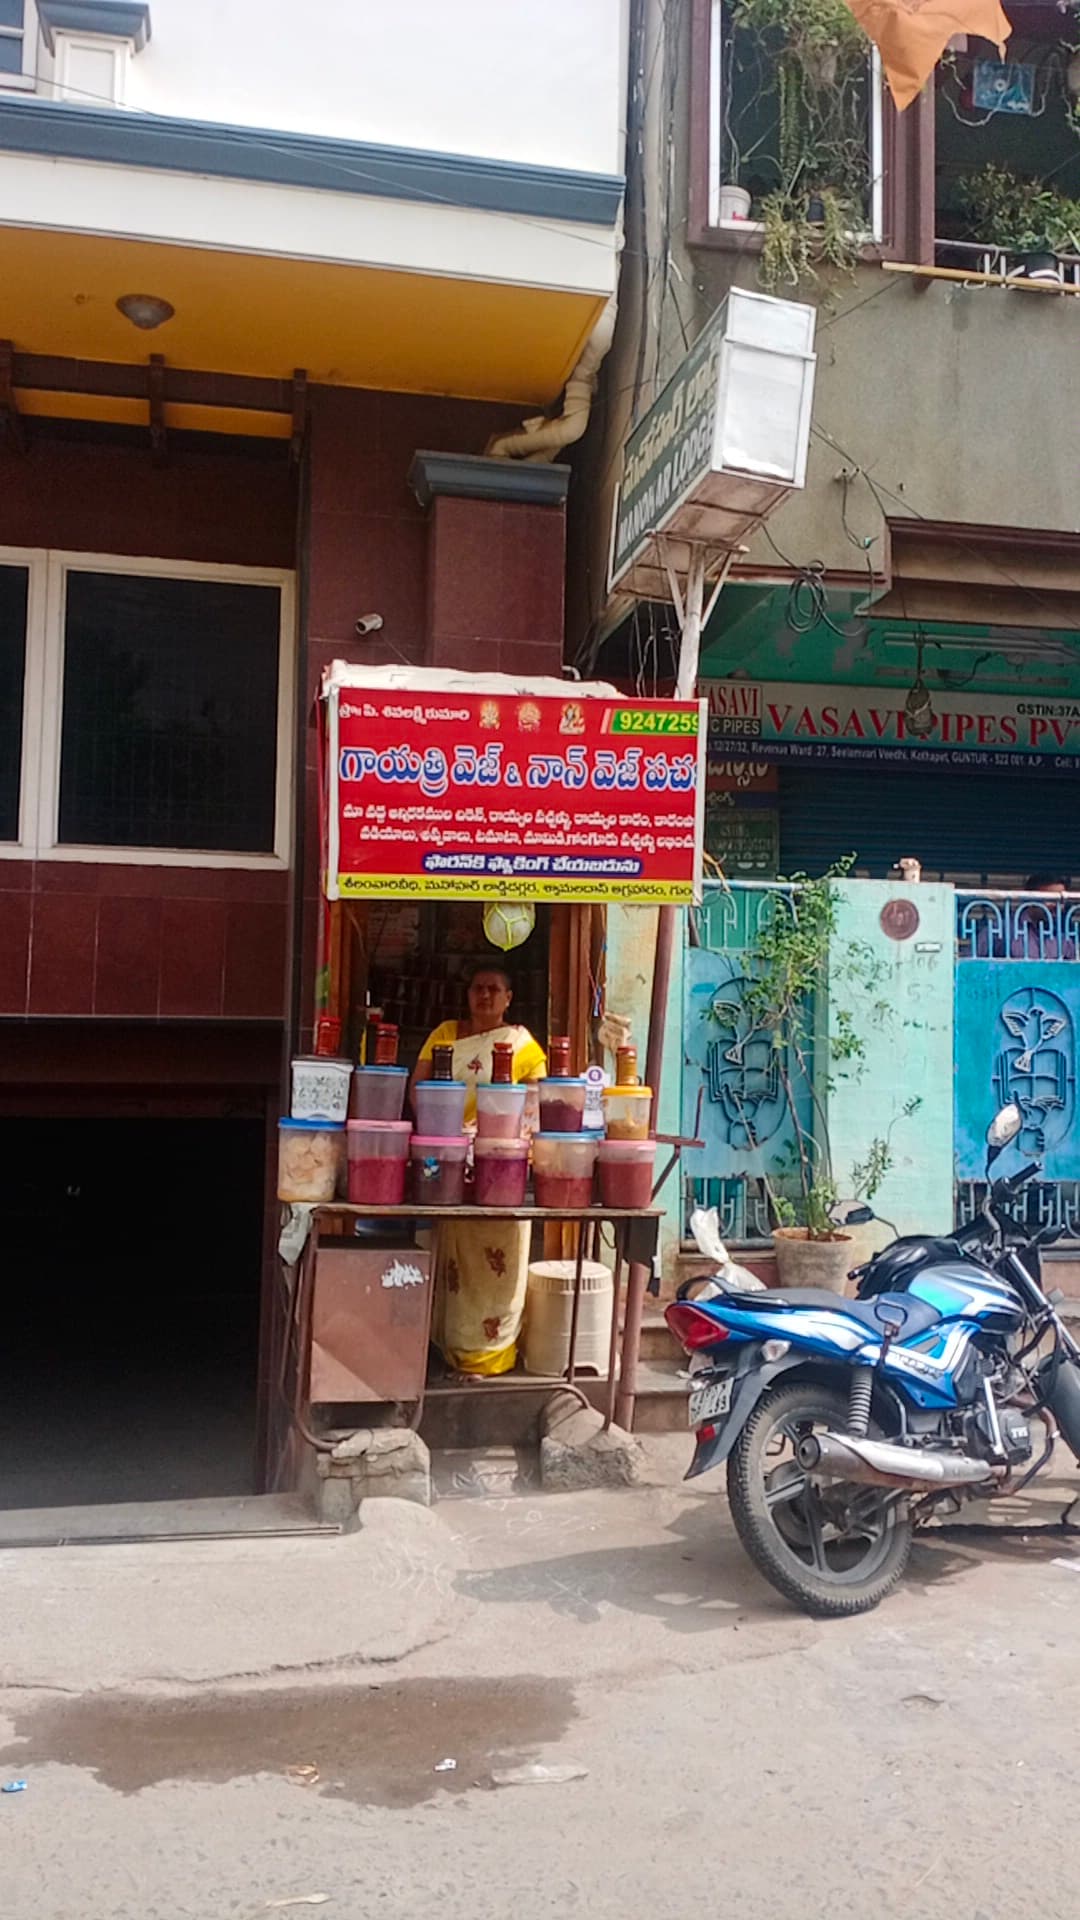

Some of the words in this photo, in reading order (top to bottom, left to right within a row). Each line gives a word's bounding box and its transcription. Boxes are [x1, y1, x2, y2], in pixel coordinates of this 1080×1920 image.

[722, 719, 760, 735] PIPES
[767, 703, 906, 741] VASAVI
[1029, 717, 1080, 748] PV
[340, 744, 448, 798] గాయత్రి
[452, 743, 503, 786] వెజ్
[505, 763, 522, 786] &
[527, 745, 588, 790] నాన్
[592, 748, 642, 790] వెజ్
